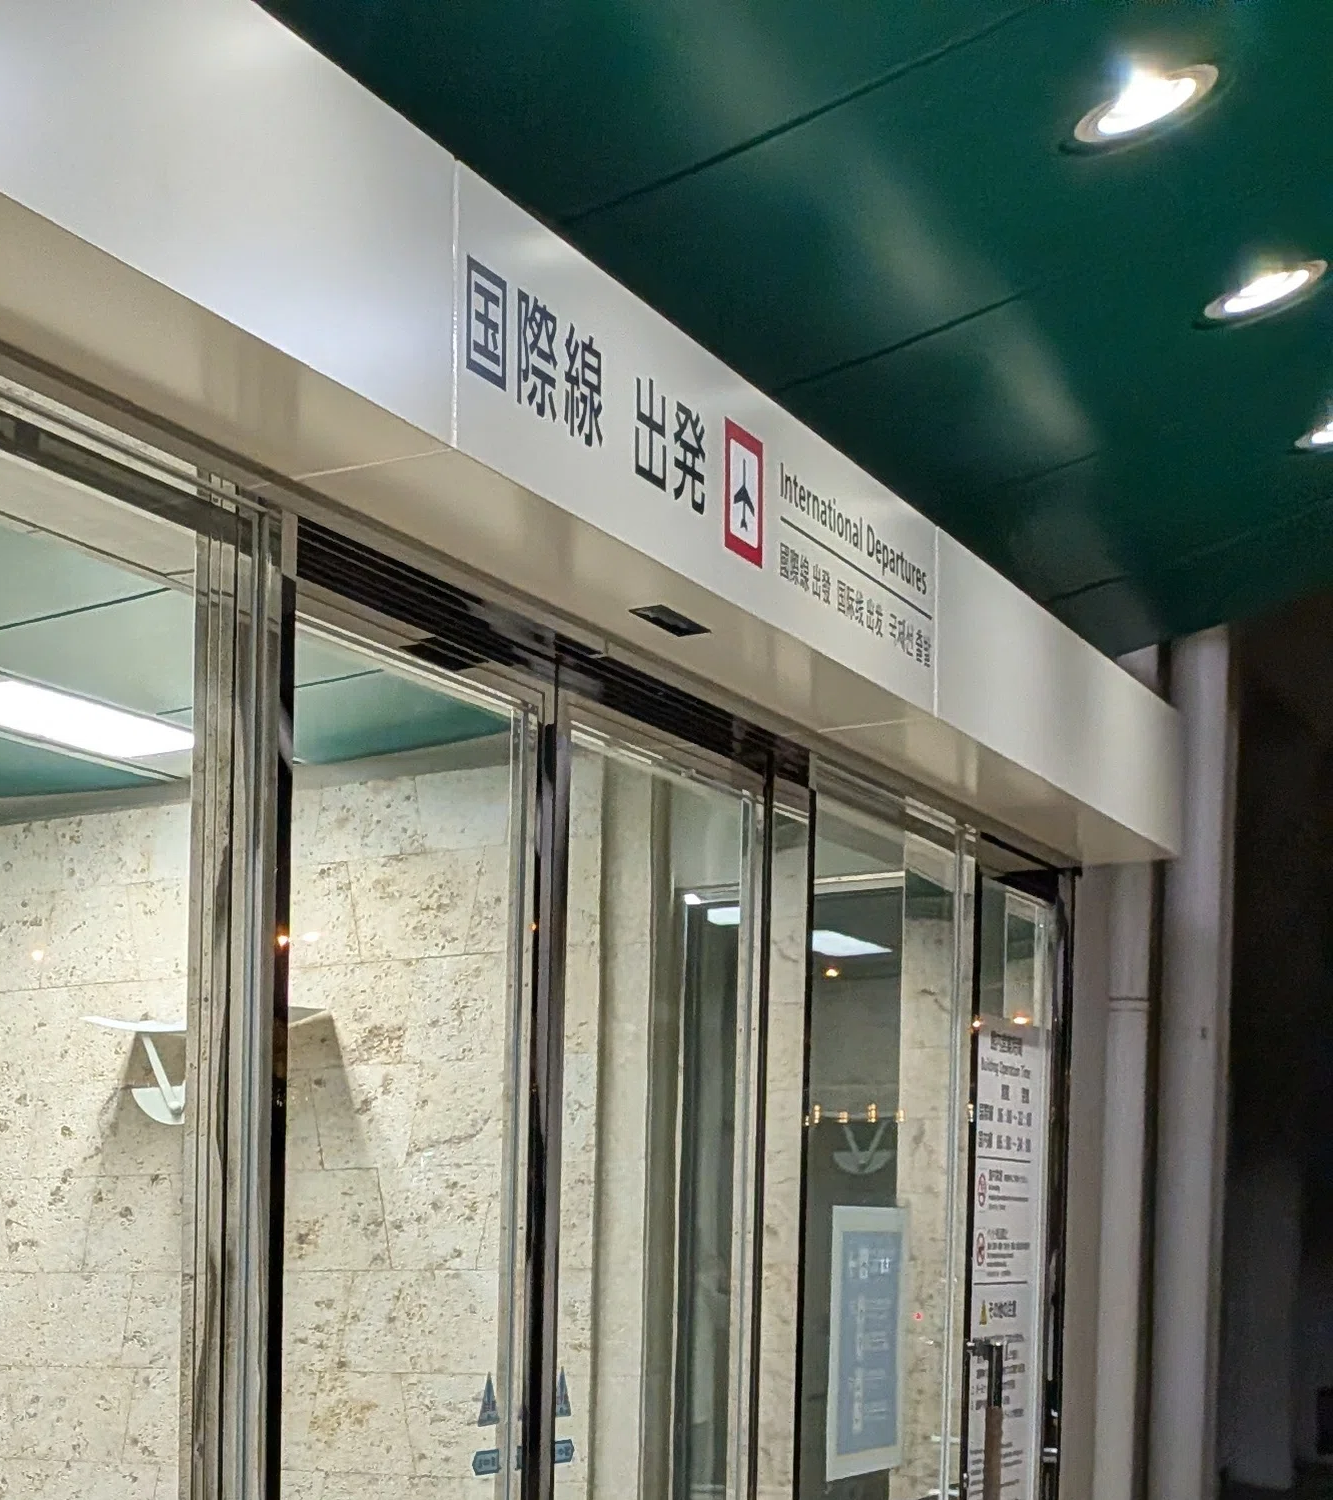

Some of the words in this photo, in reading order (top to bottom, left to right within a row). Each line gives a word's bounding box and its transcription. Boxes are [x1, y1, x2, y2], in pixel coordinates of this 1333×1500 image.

[466, 252, 603, 448] 国際線
[635, 376, 706, 515] 出発
[779, 462, 863, 552] International
[866, 523, 927, 596] Departures
